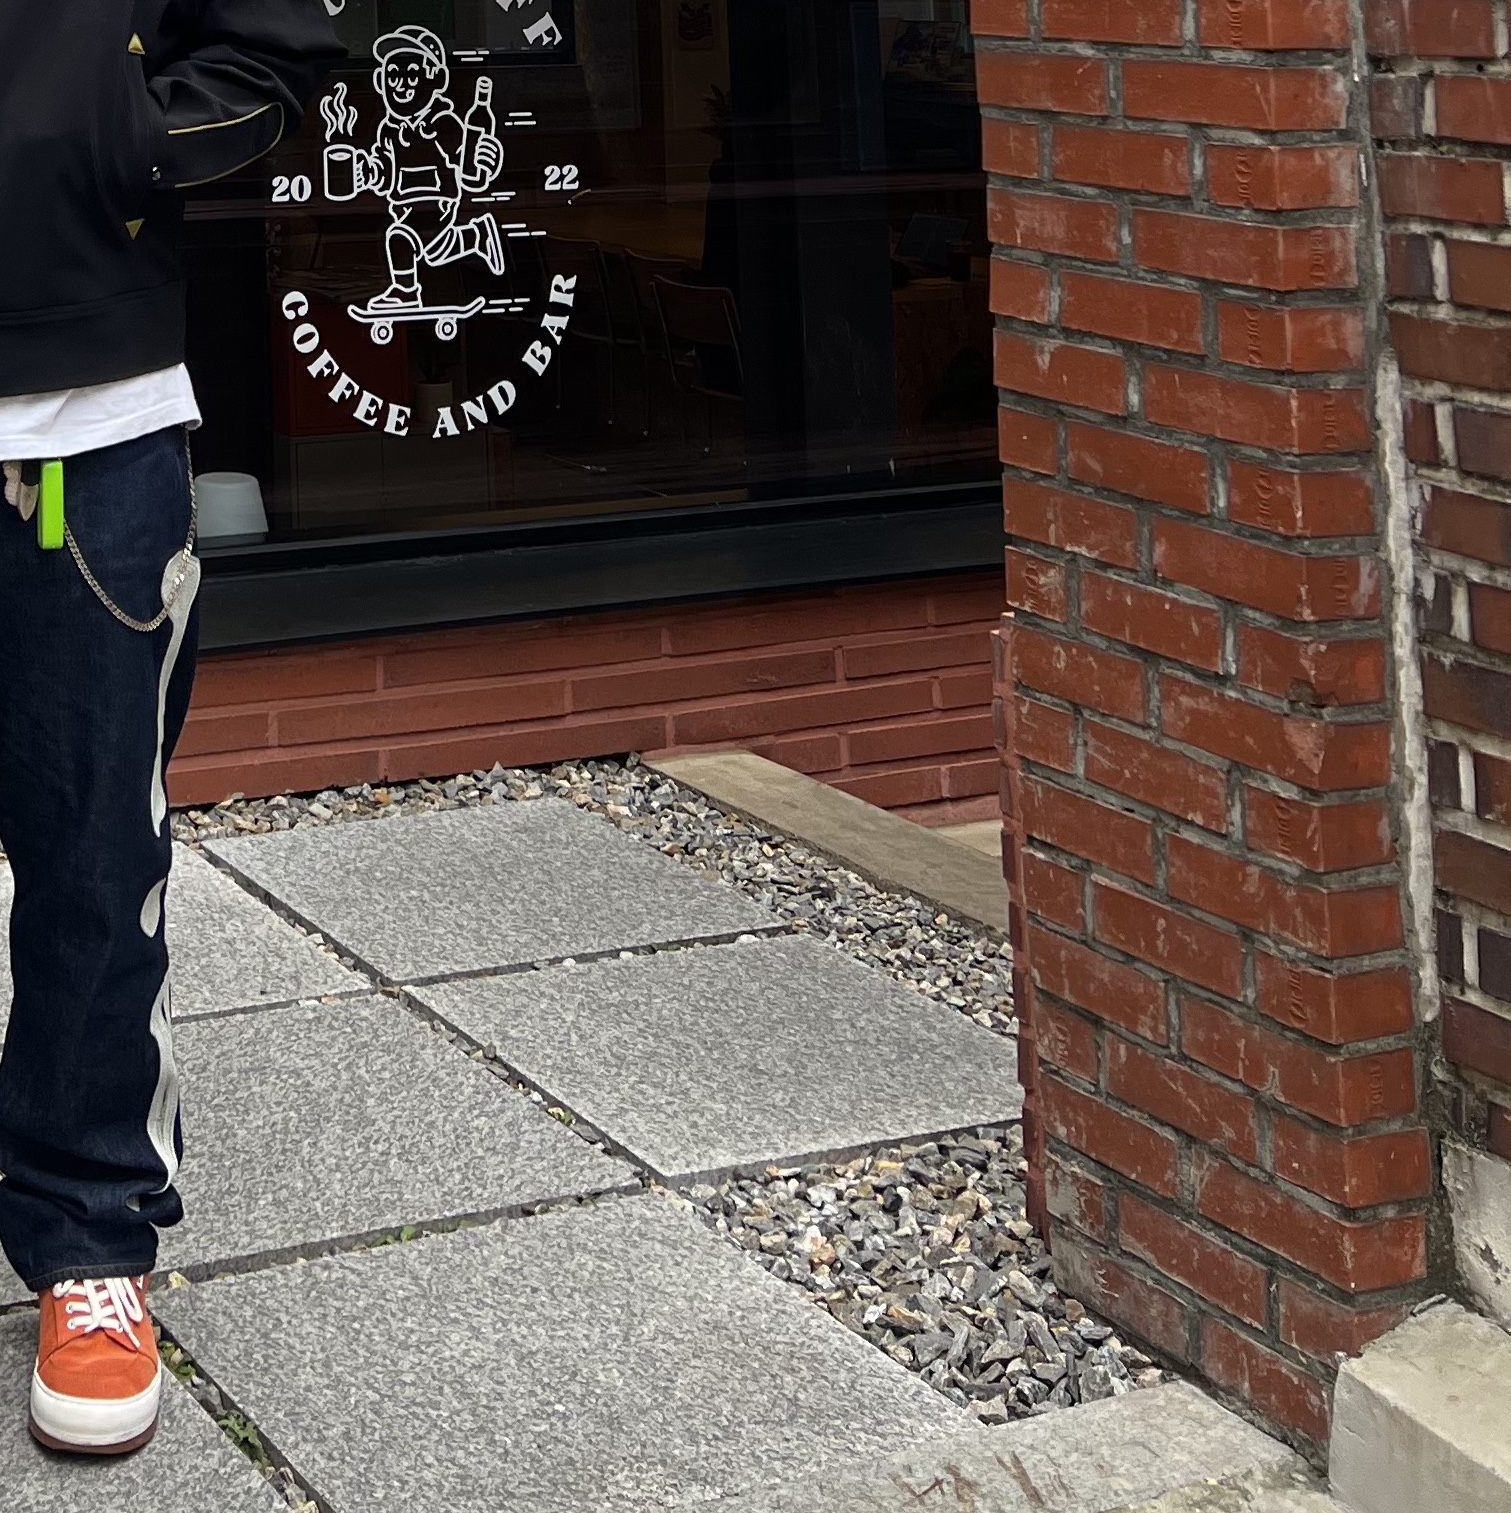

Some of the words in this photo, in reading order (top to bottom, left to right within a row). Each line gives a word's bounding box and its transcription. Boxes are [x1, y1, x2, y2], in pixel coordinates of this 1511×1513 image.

[271, 175, 311, 202] 20
[544, 164, 580, 191] 22
[282, 290, 412, 438] COFFEE
[432, 380, 517, 439] AND
[521, 273, 579, 377] BAR
